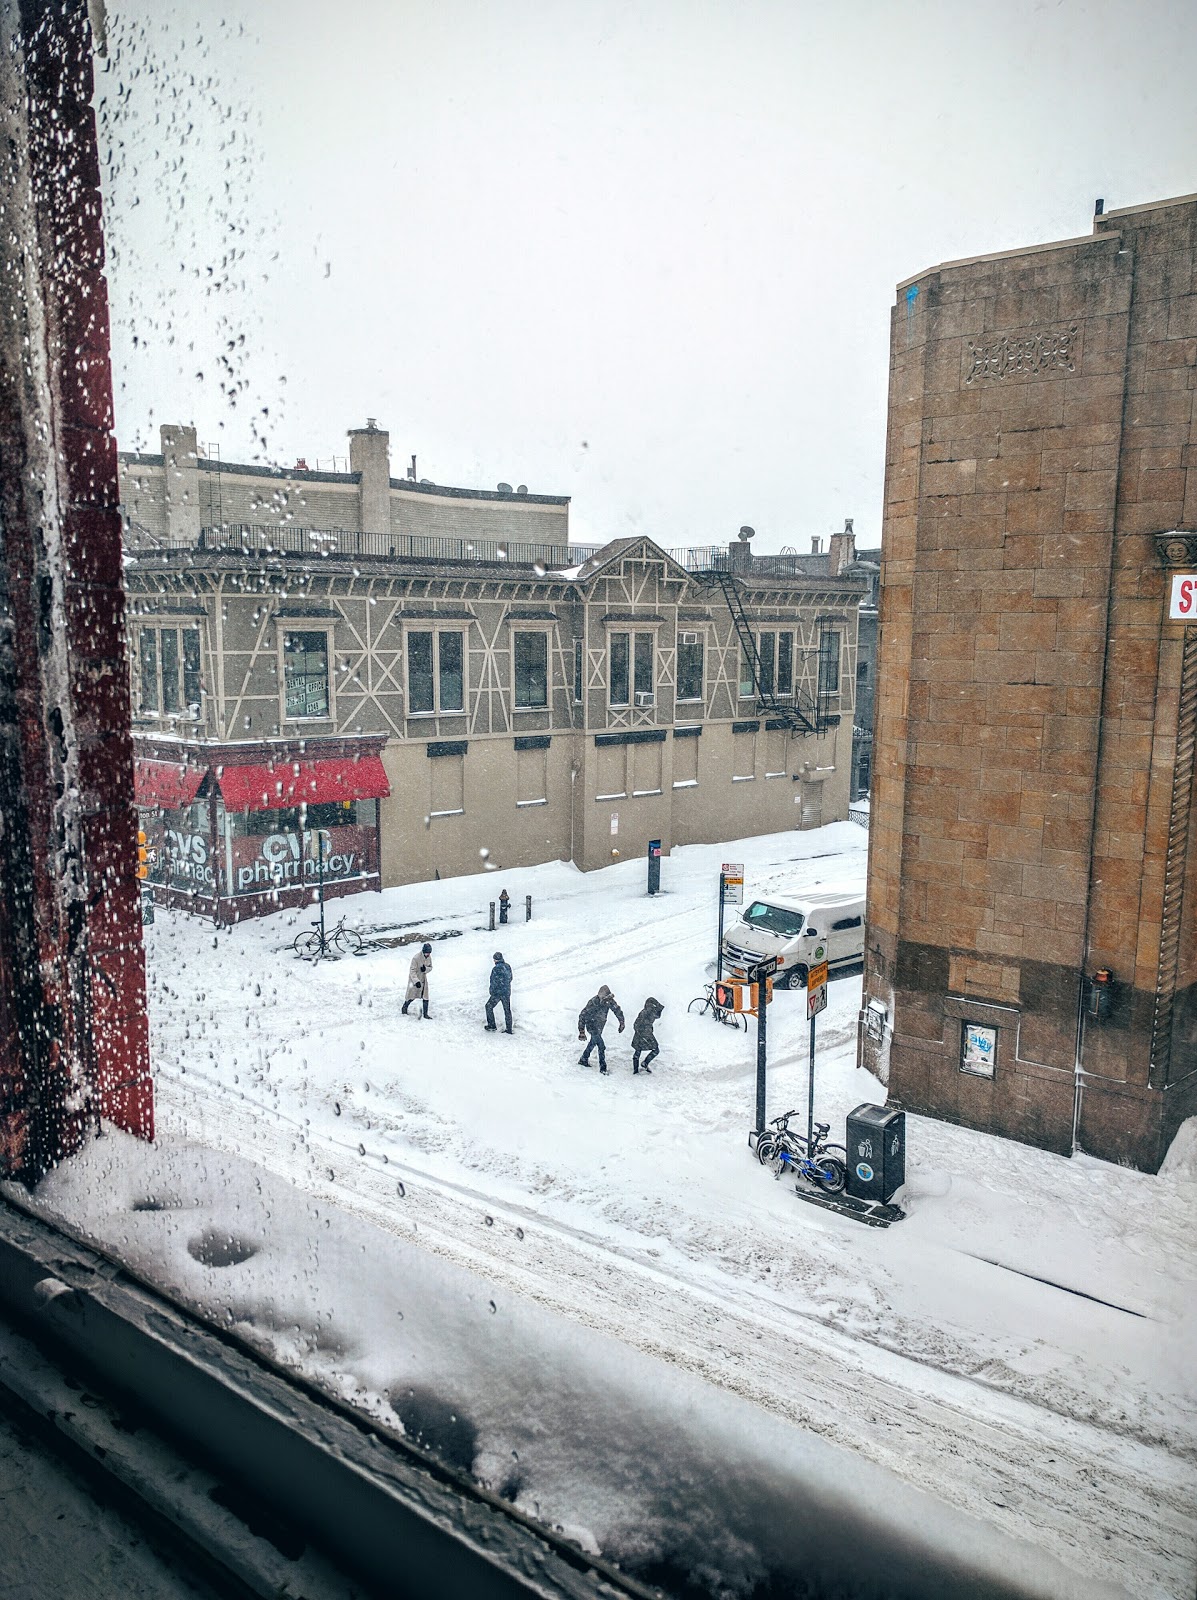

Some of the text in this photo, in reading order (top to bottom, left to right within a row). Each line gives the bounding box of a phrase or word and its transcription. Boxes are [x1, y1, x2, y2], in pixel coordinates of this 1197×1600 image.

[1178, 579, 1197, 613] S
[286, 676, 324, 692] DENTAL OFFICE
[238, 853, 354, 890] pharmacy
